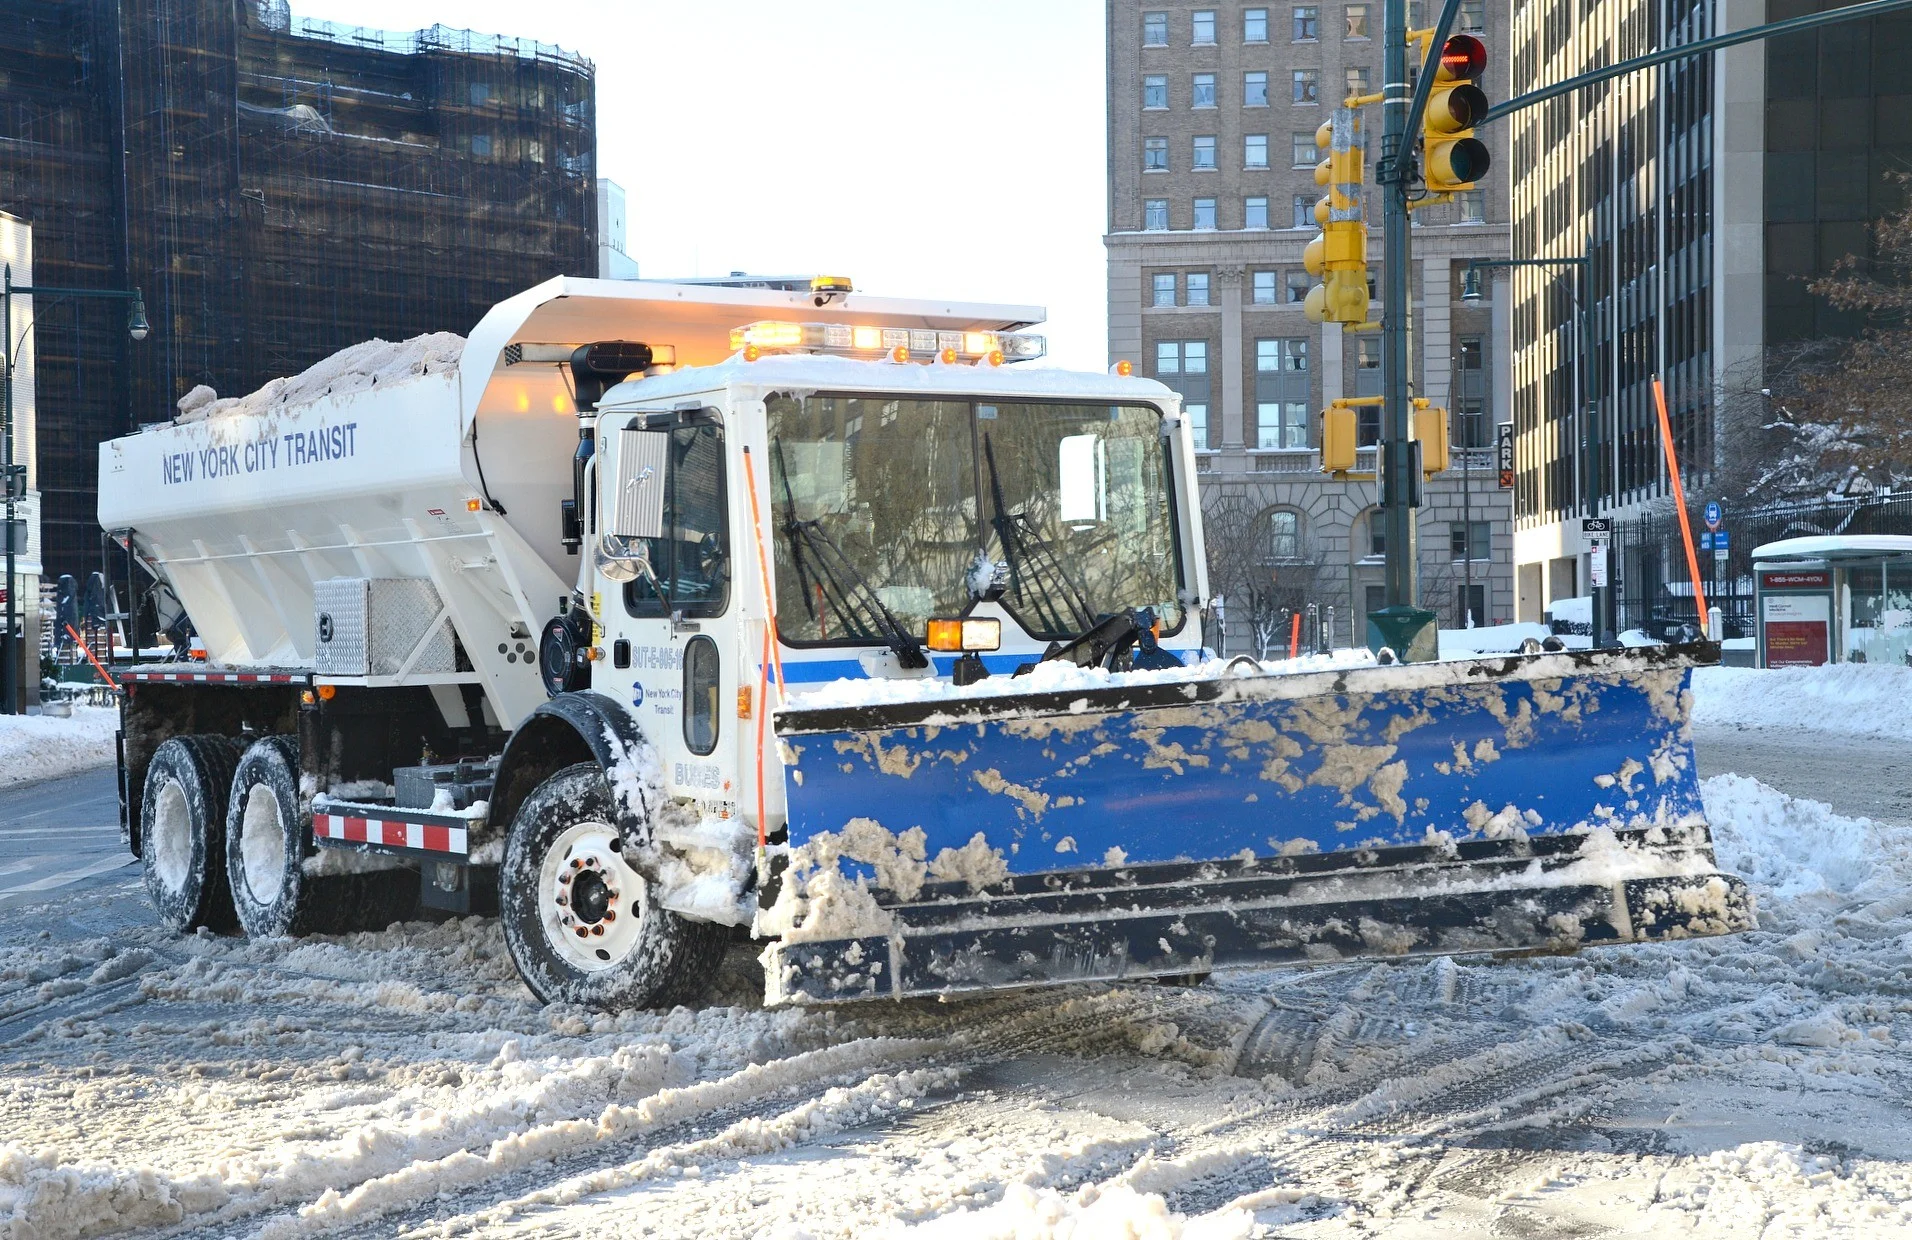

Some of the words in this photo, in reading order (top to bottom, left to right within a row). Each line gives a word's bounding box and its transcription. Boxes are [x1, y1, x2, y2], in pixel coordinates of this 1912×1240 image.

[163, 452, 194, 485] NEW
[199, 443, 240, 480] YORK
[244, 436, 279, 474] CITY
[284, 422, 358, 467] TRANSIT
[1501, 426, 1512, 470] PARK
[645, 688, 658, 699] New
[658, 688, 671, 699] York
[671, 688, 682, 701] City
[654, 704, 675, 715] Transit
